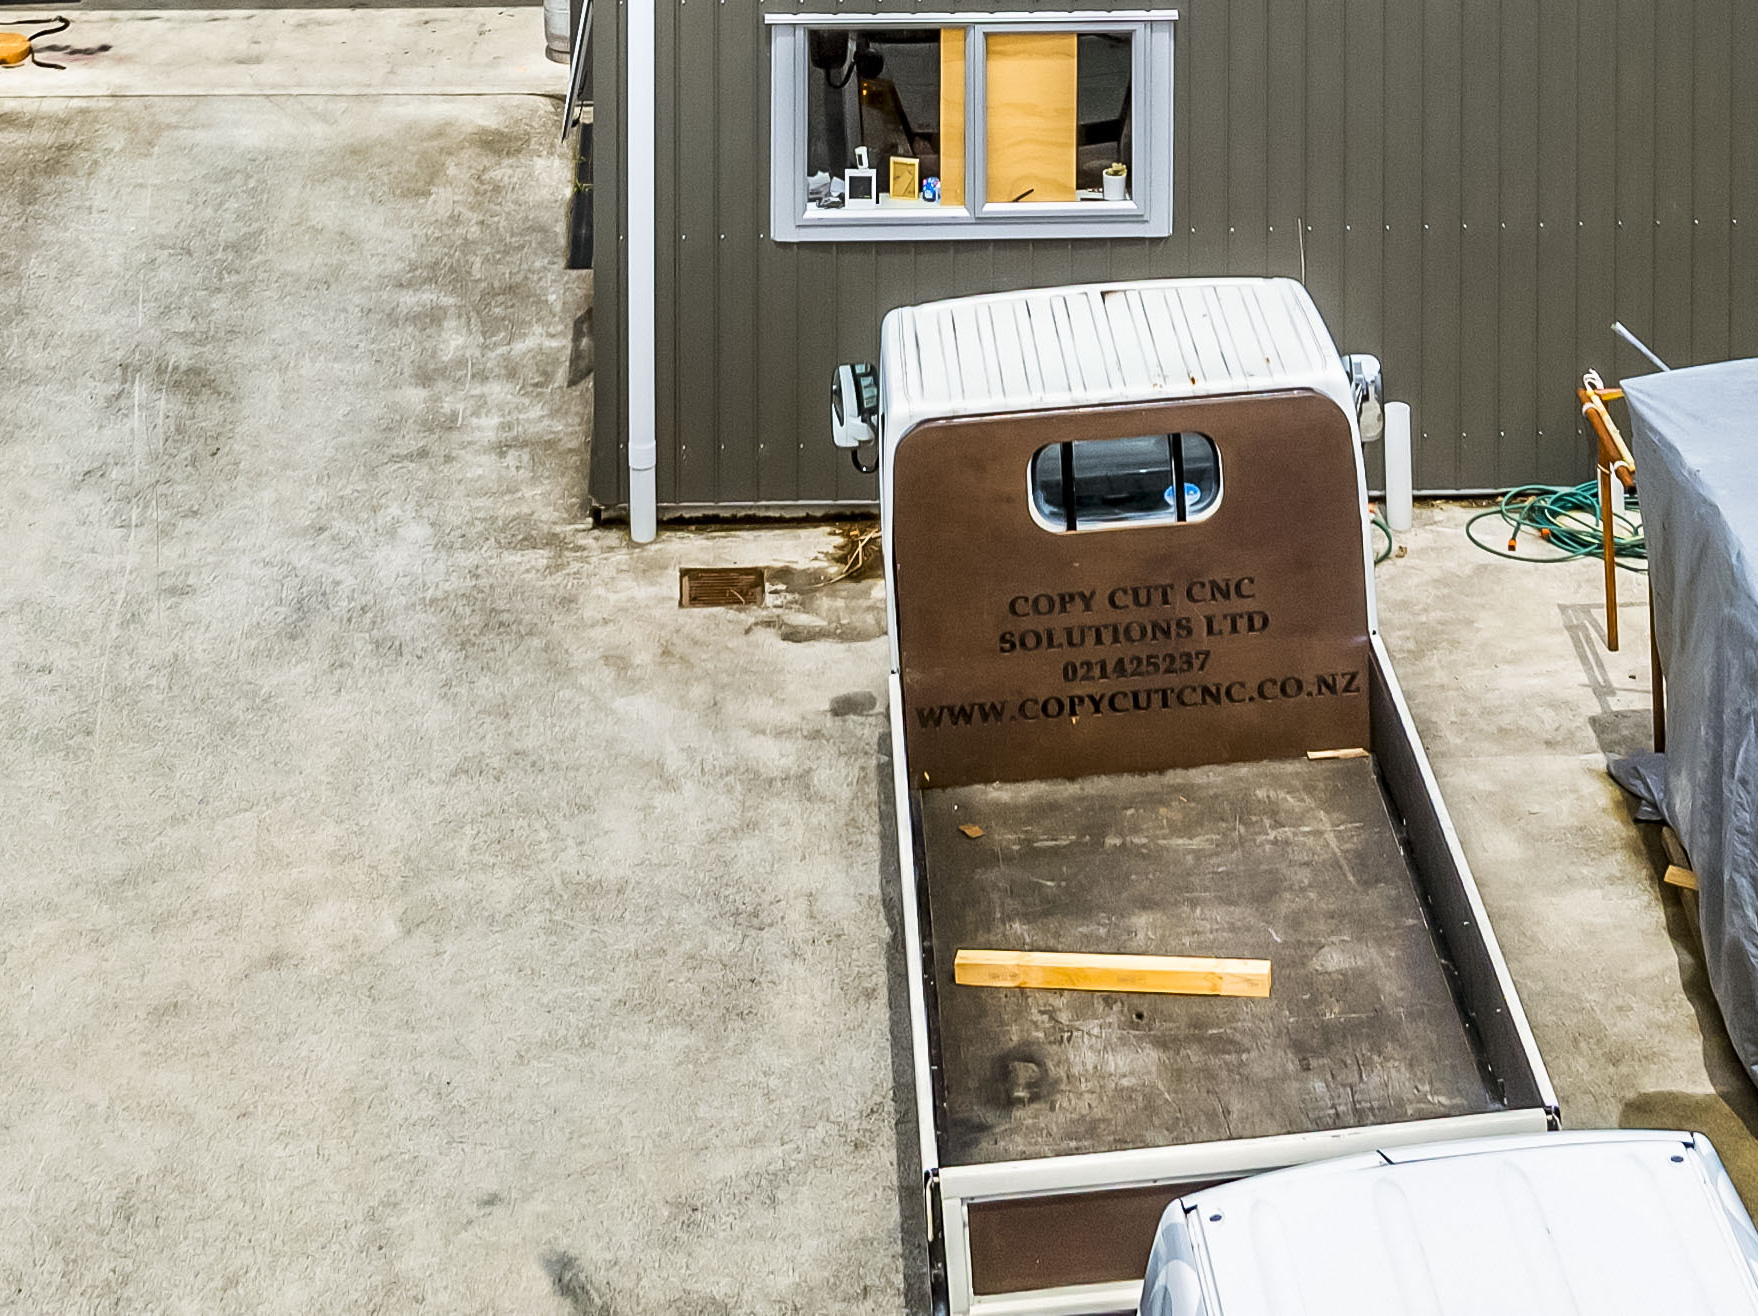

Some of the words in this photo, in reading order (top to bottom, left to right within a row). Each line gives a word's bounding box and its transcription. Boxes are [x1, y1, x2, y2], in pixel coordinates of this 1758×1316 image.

[1008, 590, 1097, 619] COPY
[1108, 583, 1175, 611] CUT
[1185, 576, 1257, 605] CNC
[999, 615, 1194, 655] SOLUTIONS
[1205, 609, 1271, 638] LTD
[1061, 649, 1212, 684] 021425237
[915, 671, 1362, 729] WWW.COPYCUTCNC.CO.NZ
